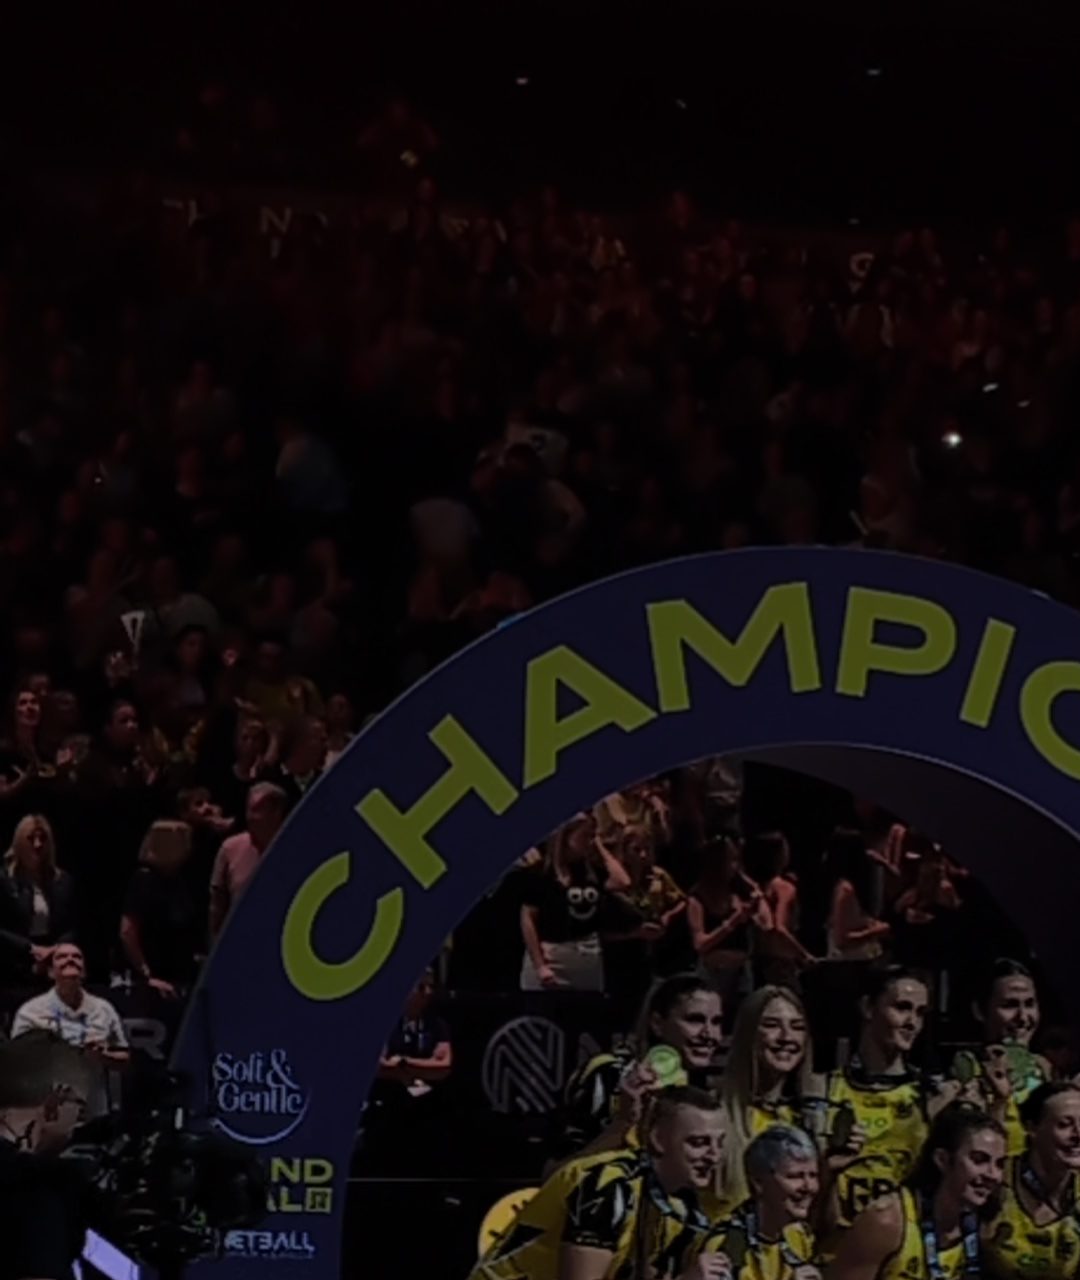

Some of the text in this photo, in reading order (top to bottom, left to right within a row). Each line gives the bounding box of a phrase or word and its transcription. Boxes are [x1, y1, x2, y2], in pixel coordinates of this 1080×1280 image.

[212, 1052, 264, 1084] Soft
[216, 1081, 303, 1114] Gentle
[224, 1229, 316, 1252] ETBALL
